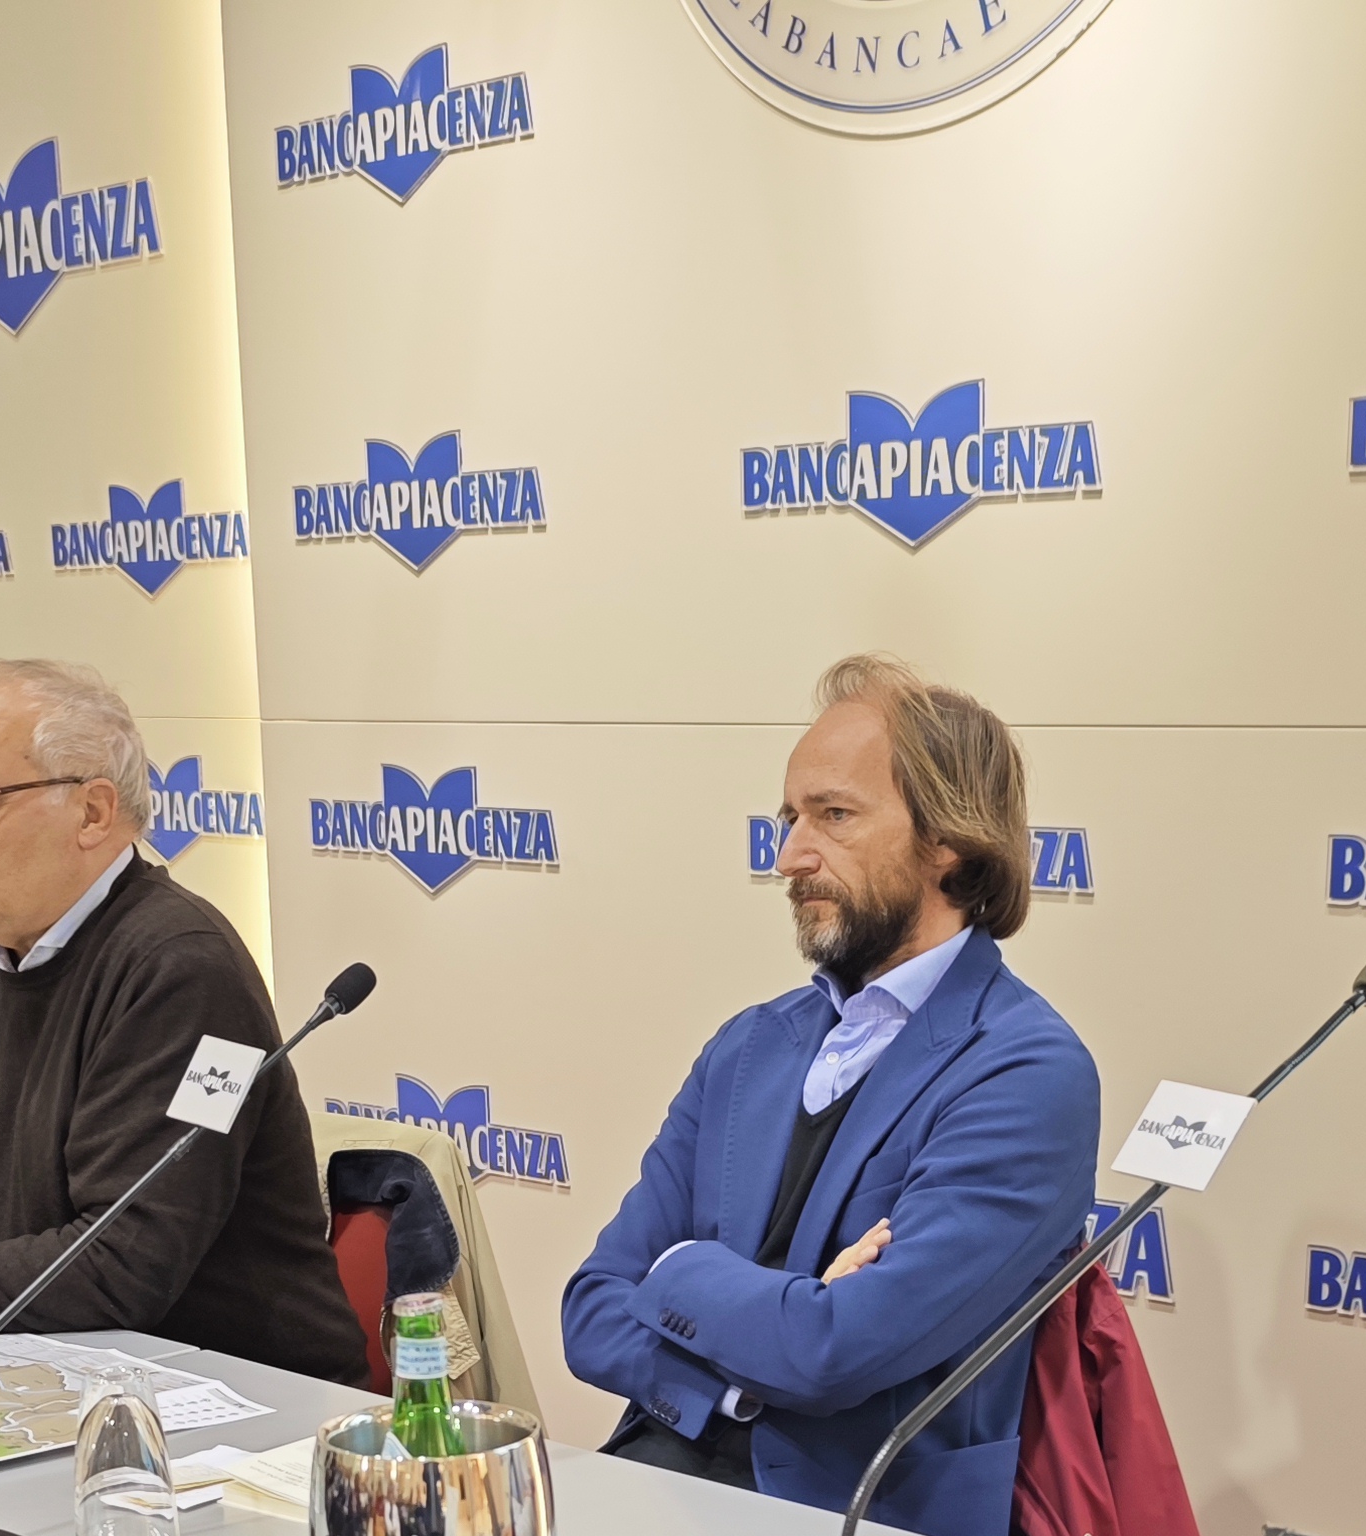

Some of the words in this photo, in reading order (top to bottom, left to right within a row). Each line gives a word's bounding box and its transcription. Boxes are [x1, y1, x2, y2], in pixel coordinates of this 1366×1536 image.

[276, 74, 533, 186] BANCAPIACENZA
[742, 424, 1098, 511] BANCAPIACENZA
[294, 468, 544, 540] BANCAPIACENZA
[52, 513, 248, 570] BANCAPIACENZA
[311, 799, 556, 864] BANCAPIACENZA
